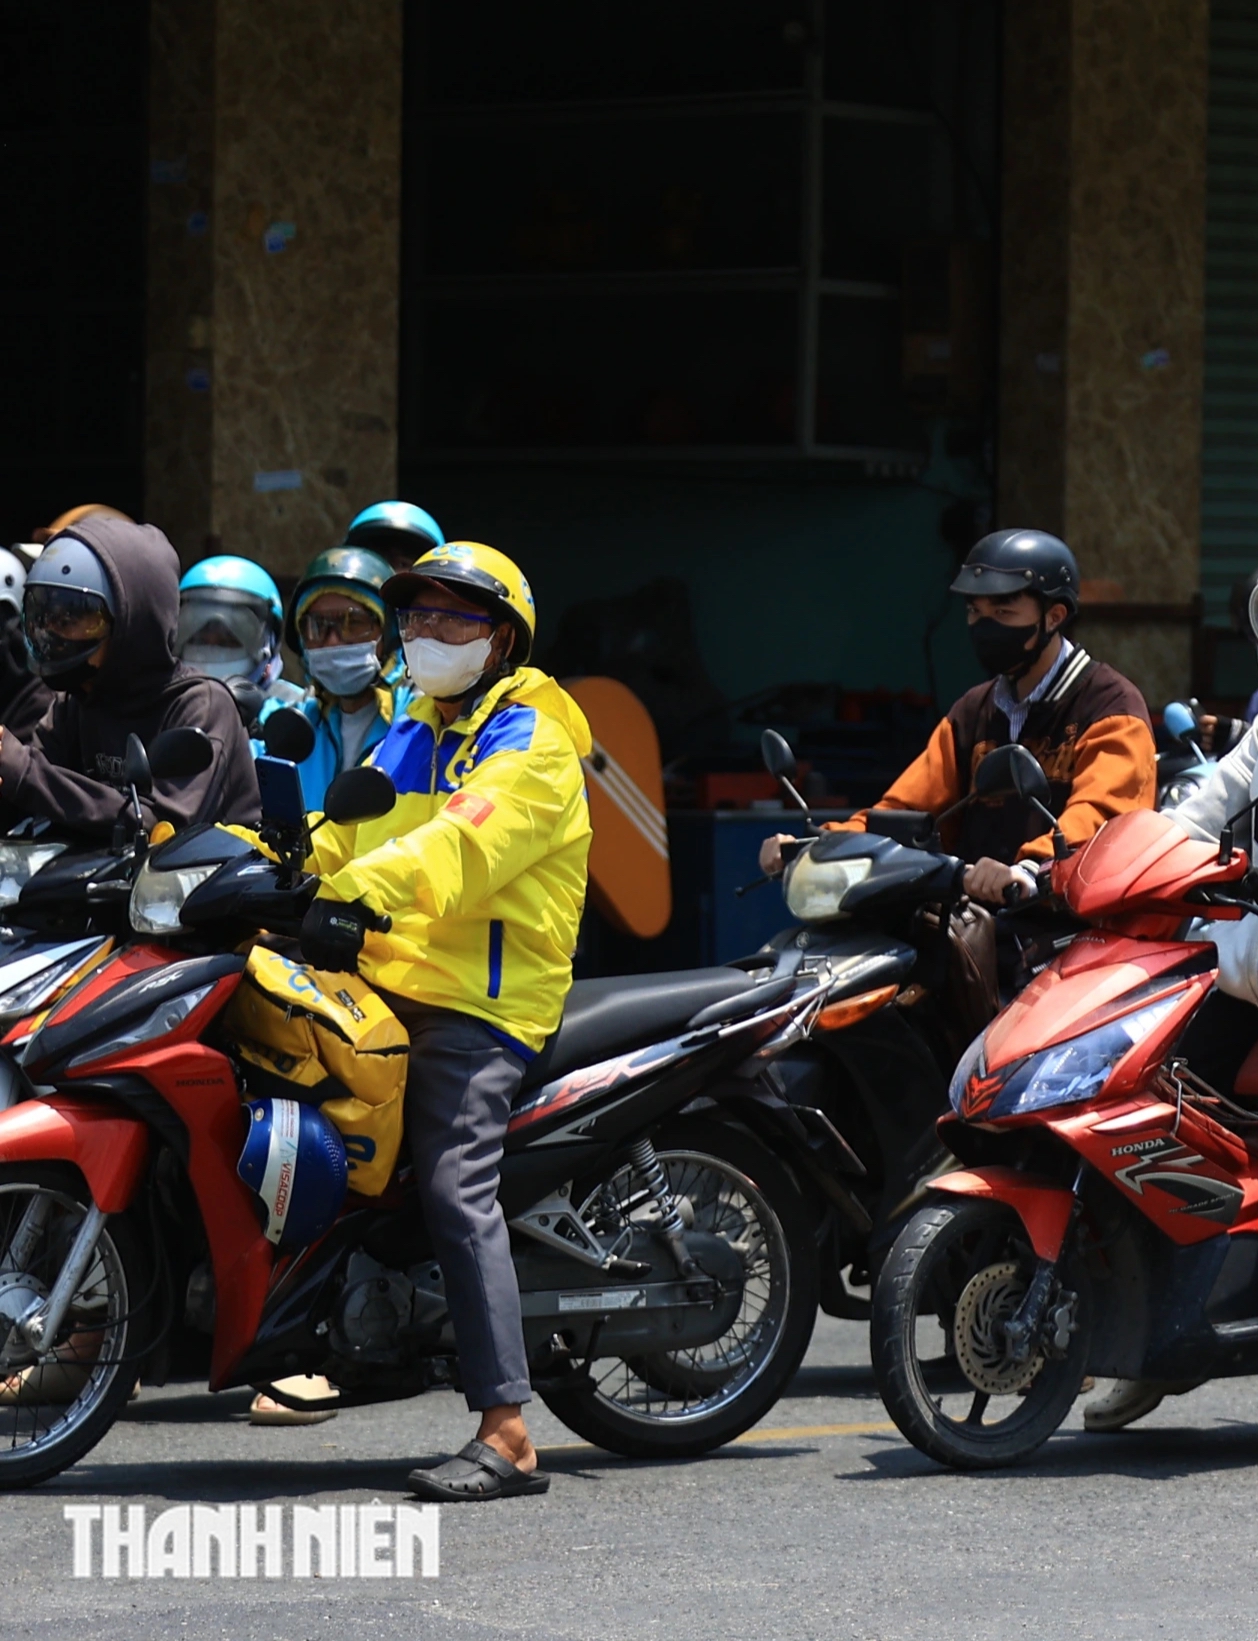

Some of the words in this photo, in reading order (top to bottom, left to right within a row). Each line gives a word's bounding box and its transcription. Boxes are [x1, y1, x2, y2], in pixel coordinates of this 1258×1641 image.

[175, 1077, 225, 1087] HONDA
[1111, 1138, 1165, 1156] HONDA
[275, 1162, 292, 1217] VISACOOP
